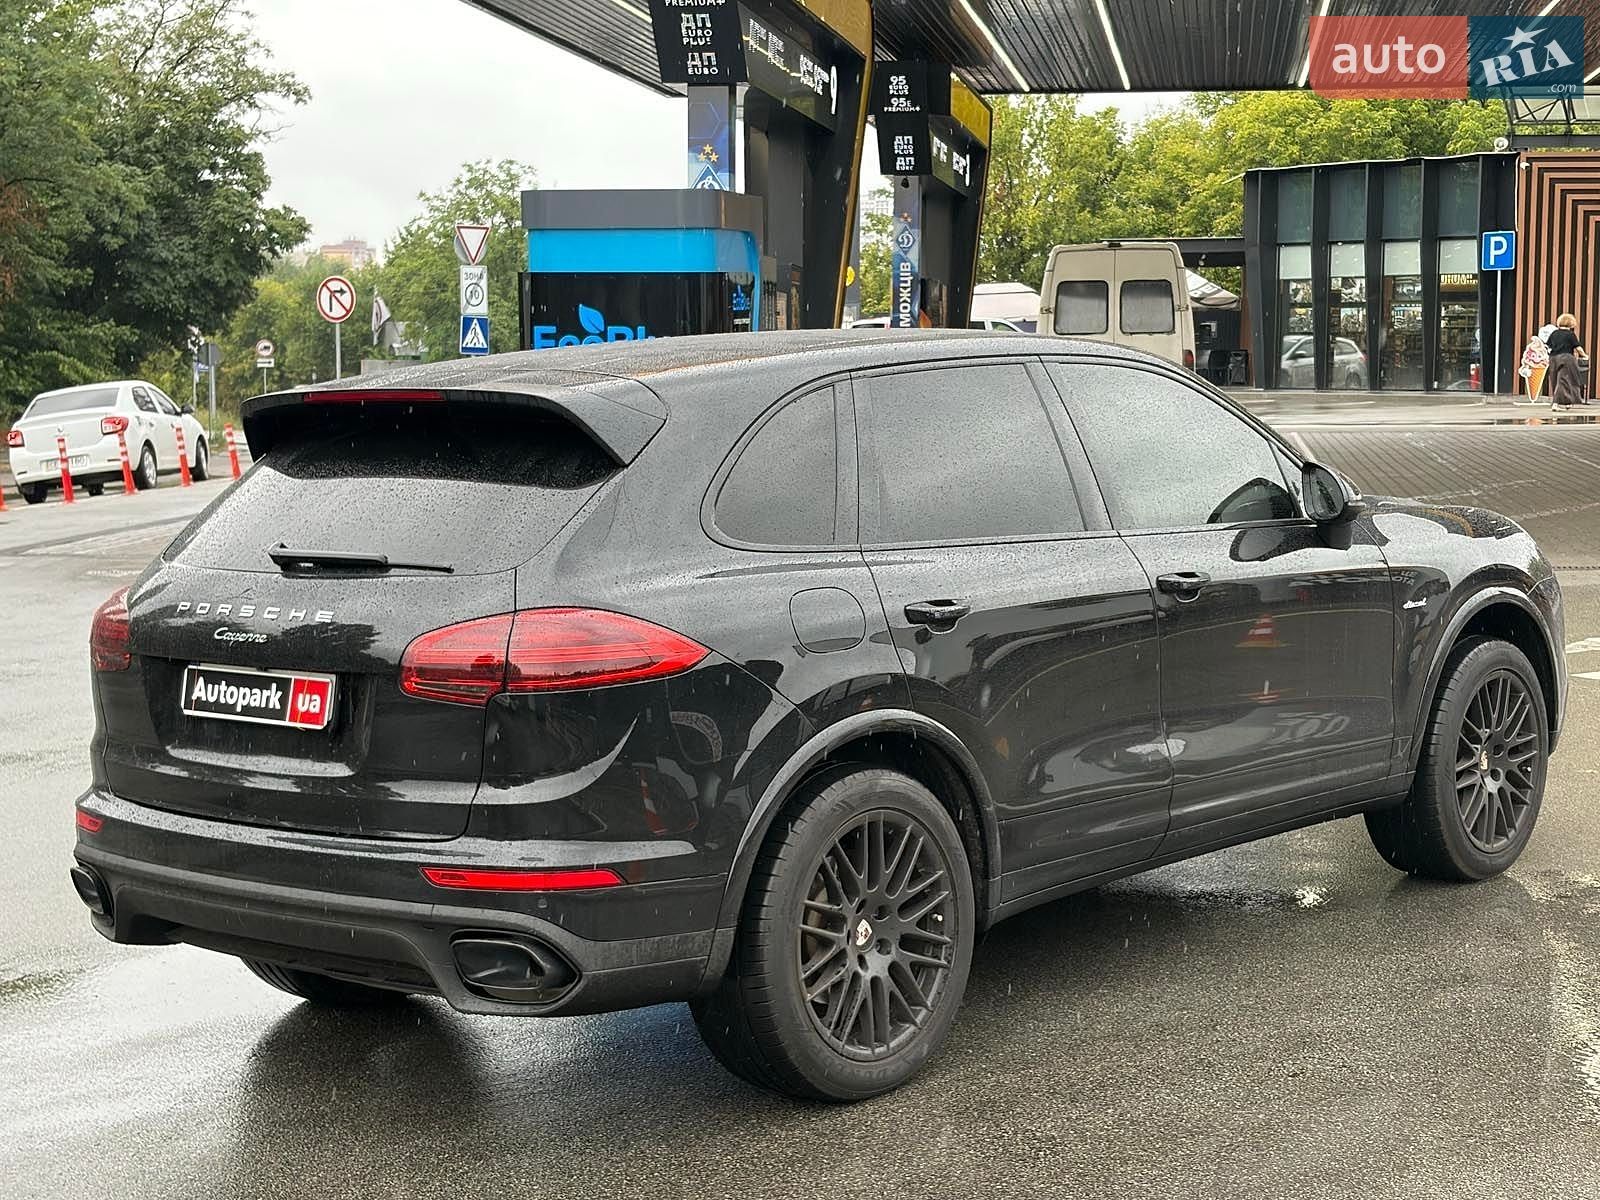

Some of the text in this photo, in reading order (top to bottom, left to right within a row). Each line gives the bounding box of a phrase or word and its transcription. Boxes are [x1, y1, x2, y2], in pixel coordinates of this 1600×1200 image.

[681, 13, 711, 29] ДП
[682, 29, 712, 37] EURO
[687, 52, 717, 67] ДП
[687, 67, 718, 75] EURO
[890, 76, 906, 85] 95
[1490, 236, 1507, 265] P
[176, 601, 335, 623] PORSCHE
[213, 627, 269, 646] Cayenne
[191, 675, 321, 713] Autopark ua
